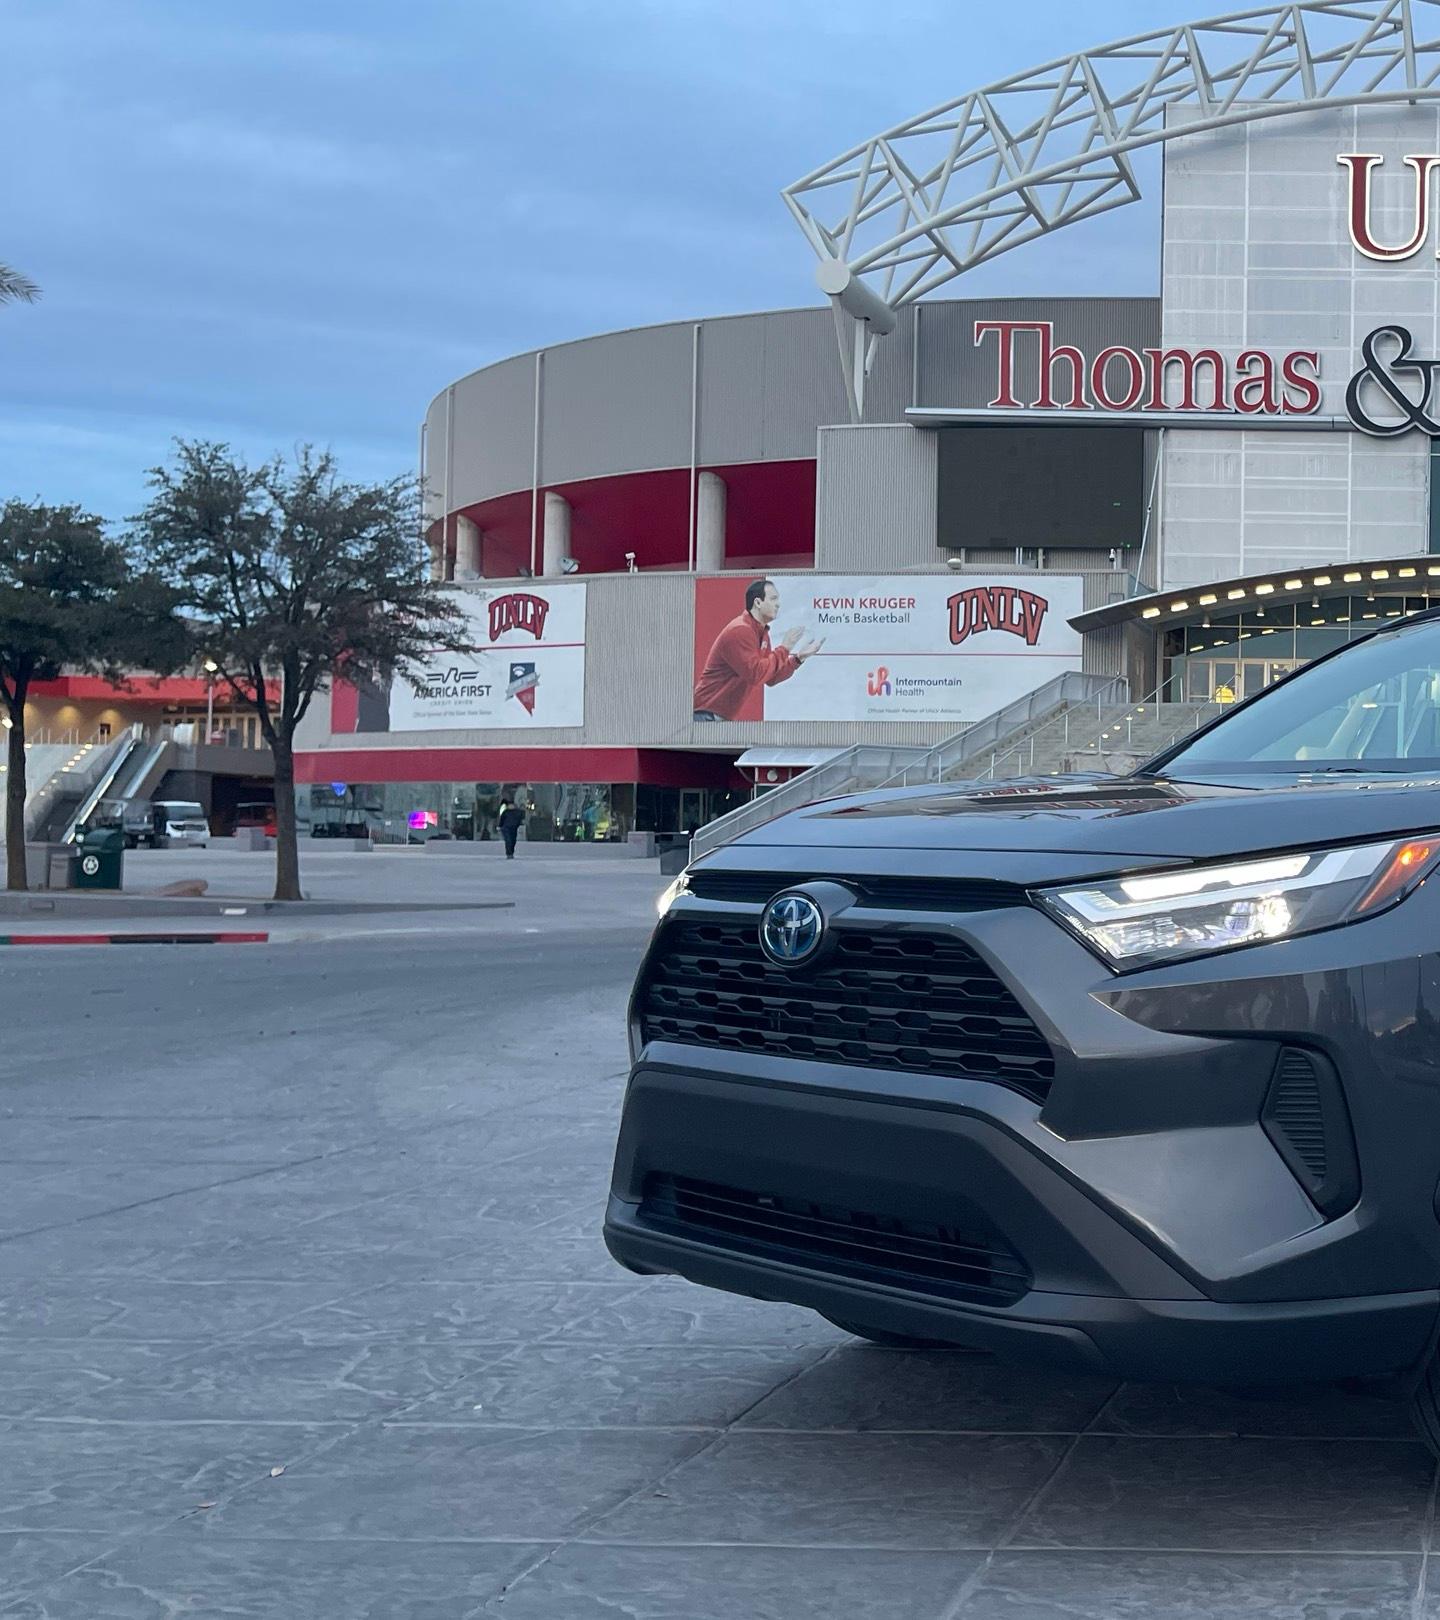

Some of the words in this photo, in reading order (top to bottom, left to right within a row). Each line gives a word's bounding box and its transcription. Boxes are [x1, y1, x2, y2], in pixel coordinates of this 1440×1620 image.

[974, 320, 1322, 415] Thomas
[813, 598, 855, 609] KEVIN
[859, 597, 916, 609] KRUGER
[488, 593, 549, 641] UNLV
[818, 612, 850, 624] Men's
[853, 612, 911, 624] Basketball
[947, 586, 1049, 646] UNLV
[895, 677, 962, 688] Intermountain
[414, 686, 458, 699] AMERICA
[461, 685, 492, 697] FIRST
[895, 688, 925, 697] Health
